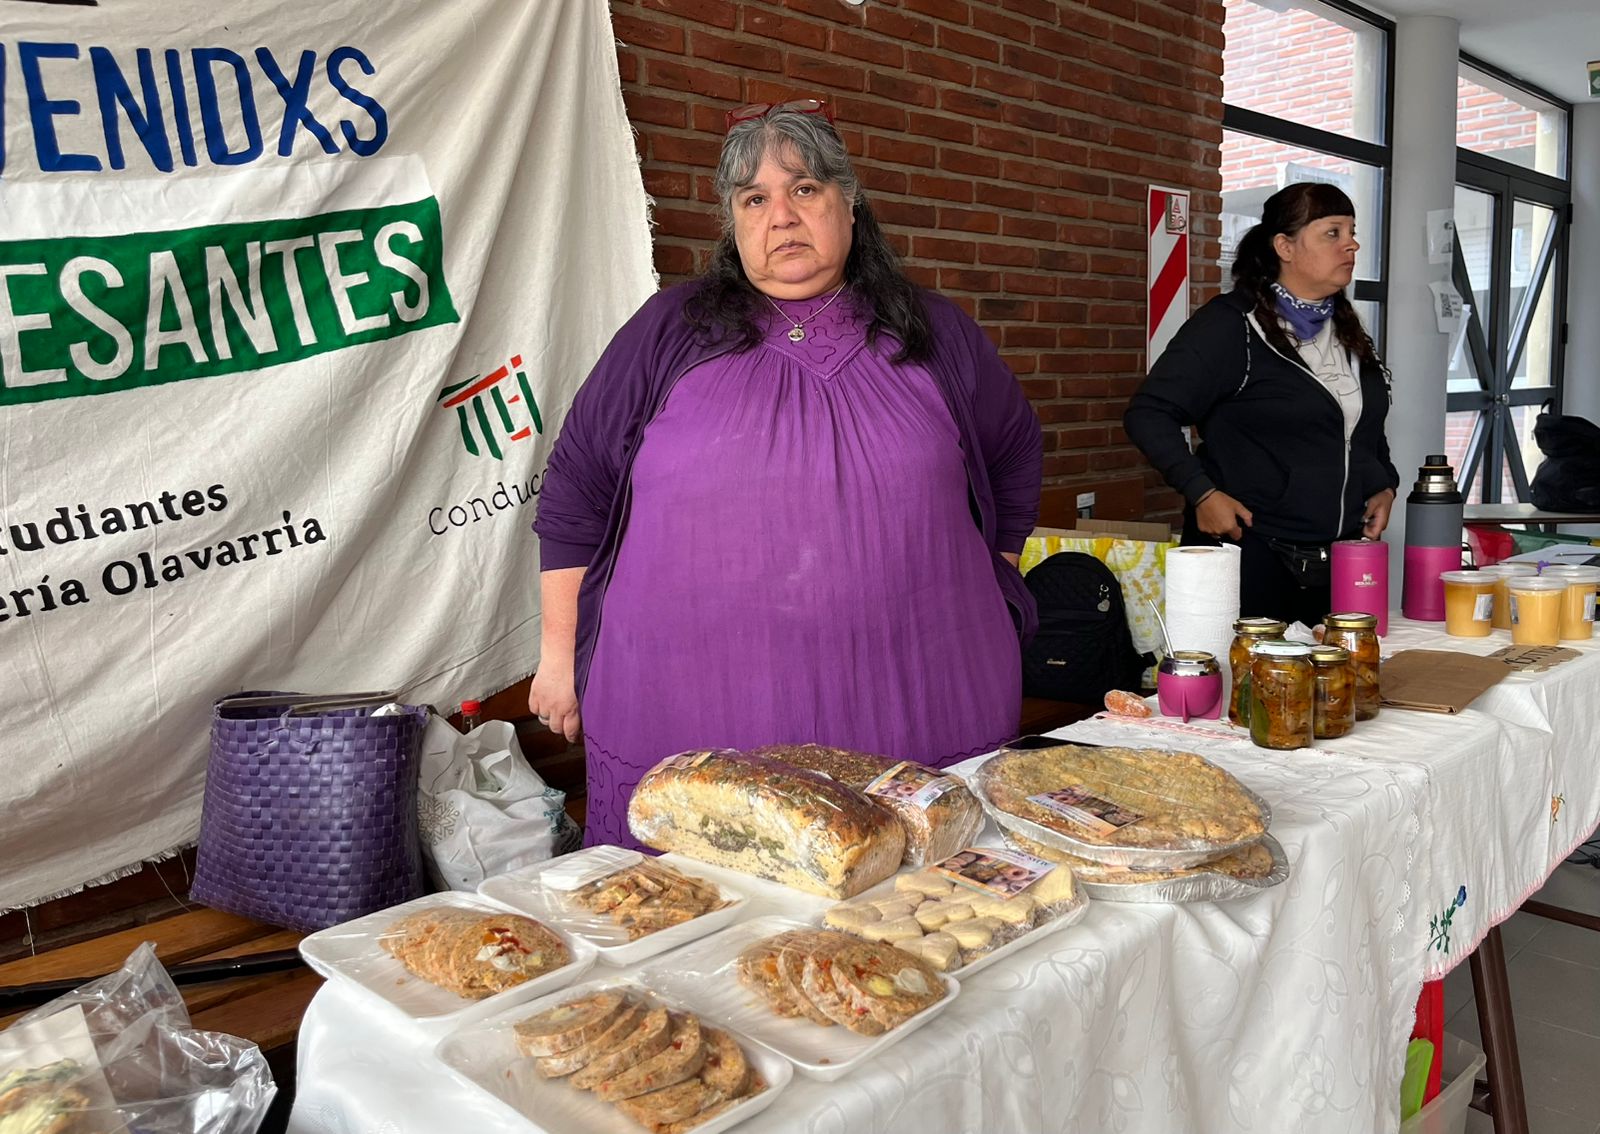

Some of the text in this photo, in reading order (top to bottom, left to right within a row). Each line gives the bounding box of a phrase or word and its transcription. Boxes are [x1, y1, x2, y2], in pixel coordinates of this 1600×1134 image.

[0, 41, 389, 176] ENIDXS
[0, 221, 430, 388] ESANTES
[102, 510, 327, 596] Olavarría
